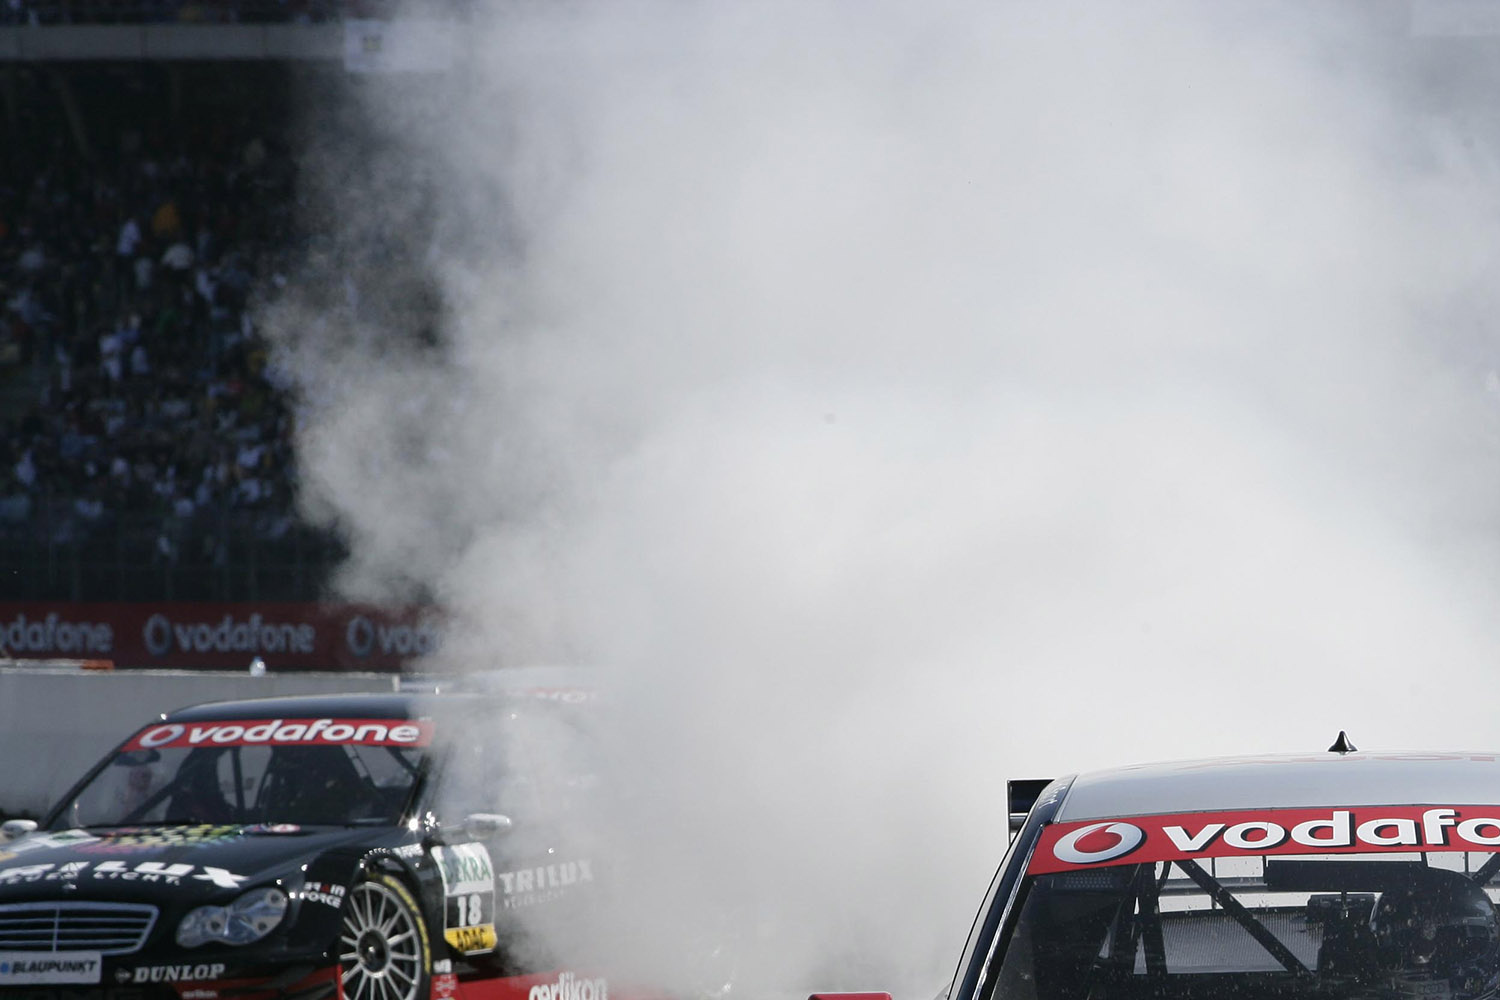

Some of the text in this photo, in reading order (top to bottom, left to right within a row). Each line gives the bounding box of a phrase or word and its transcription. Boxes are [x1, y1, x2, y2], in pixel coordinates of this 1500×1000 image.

[174, 612, 315, 653] vodafone
[187, 720, 420, 744] vodafone
[499, 859, 593, 893] TRILUX
[457, 894, 482, 927] 18
[12, 961, 97, 975] BLAUPUNKT
[133, 964, 225, 983] DUNLOP
